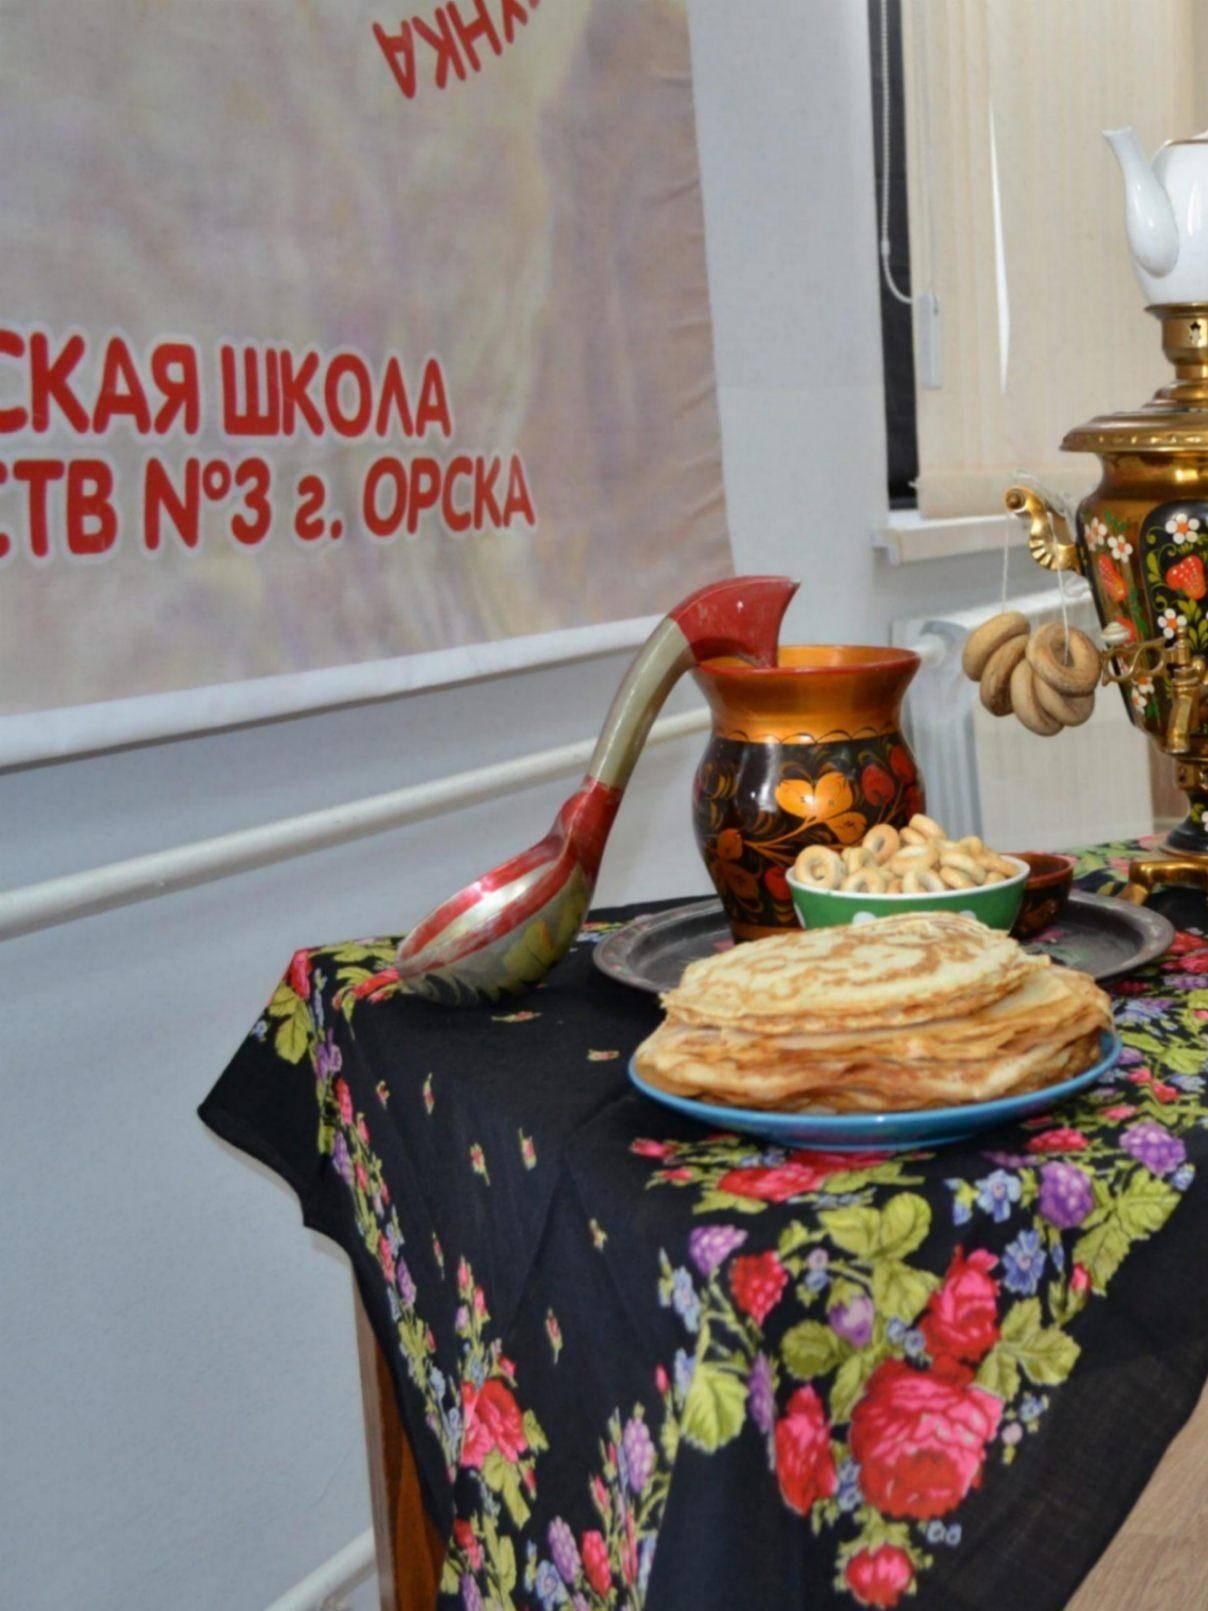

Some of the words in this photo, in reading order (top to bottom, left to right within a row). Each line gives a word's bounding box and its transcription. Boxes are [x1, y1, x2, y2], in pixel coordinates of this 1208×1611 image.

[372, 0, 540, 99] УНКА
[220, 344, 452, 438] ШКОЛА
[0, 458, 118, 557] ТВ
[294, 475, 343, 541] г.
[362, 453, 536, 537] ОРСКА
